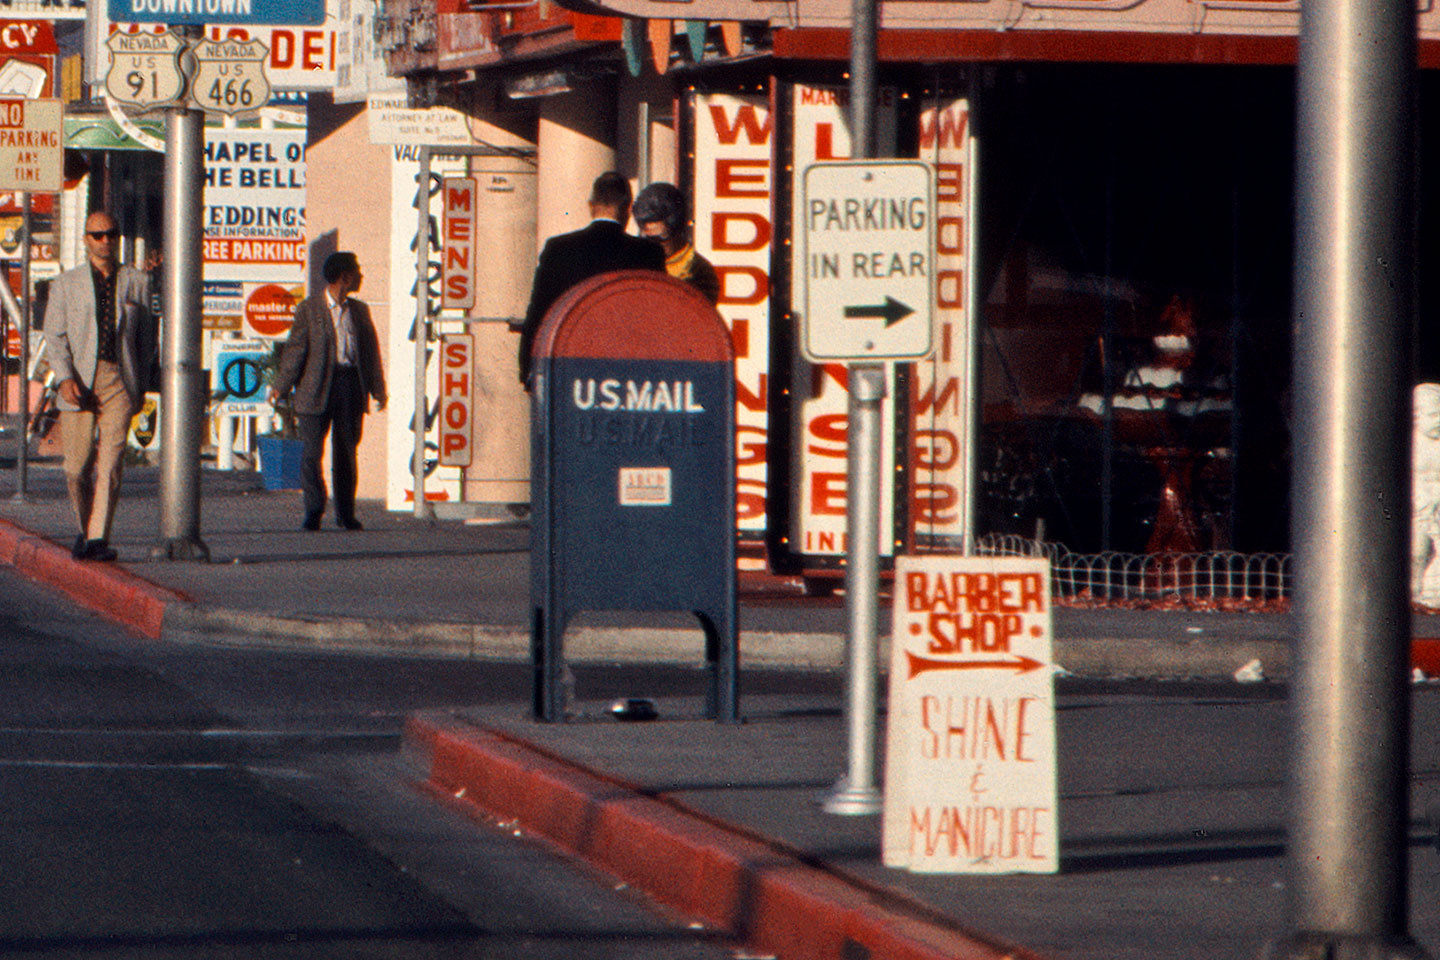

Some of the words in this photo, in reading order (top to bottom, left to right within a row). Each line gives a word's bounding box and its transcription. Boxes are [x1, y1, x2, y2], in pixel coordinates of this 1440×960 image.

[119, 38, 168, 51] NEVADA
[205, 46, 257, 58] NEVADA
[126, 71, 159, 99] 91
[208, 79, 253, 107] 466
[0, 130, 58, 148] PARKING
[17, 152, 39, 165] ANY
[15, 168, 42, 182] TIME
[240, 168, 306, 188] BELL
[810, 198, 926, 231] PARKING
[224, 227, 299, 238] INFORMATION
[448, 188, 471, 300] MENS
[232, 242, 307, 261] PARKING
[812, 253, 840, 279] IN
[853, 251, 927, 279] REAR
[248, 302, 288, 313] master
[445, 343, 469, 457] SHOP
[904, 571, 1046, 613] BARBER
[927, 613, 1024, 655] SHOP
[921, 695, 1037, 762] SHINE
[909, 806, 1051, 861] MANICURE
